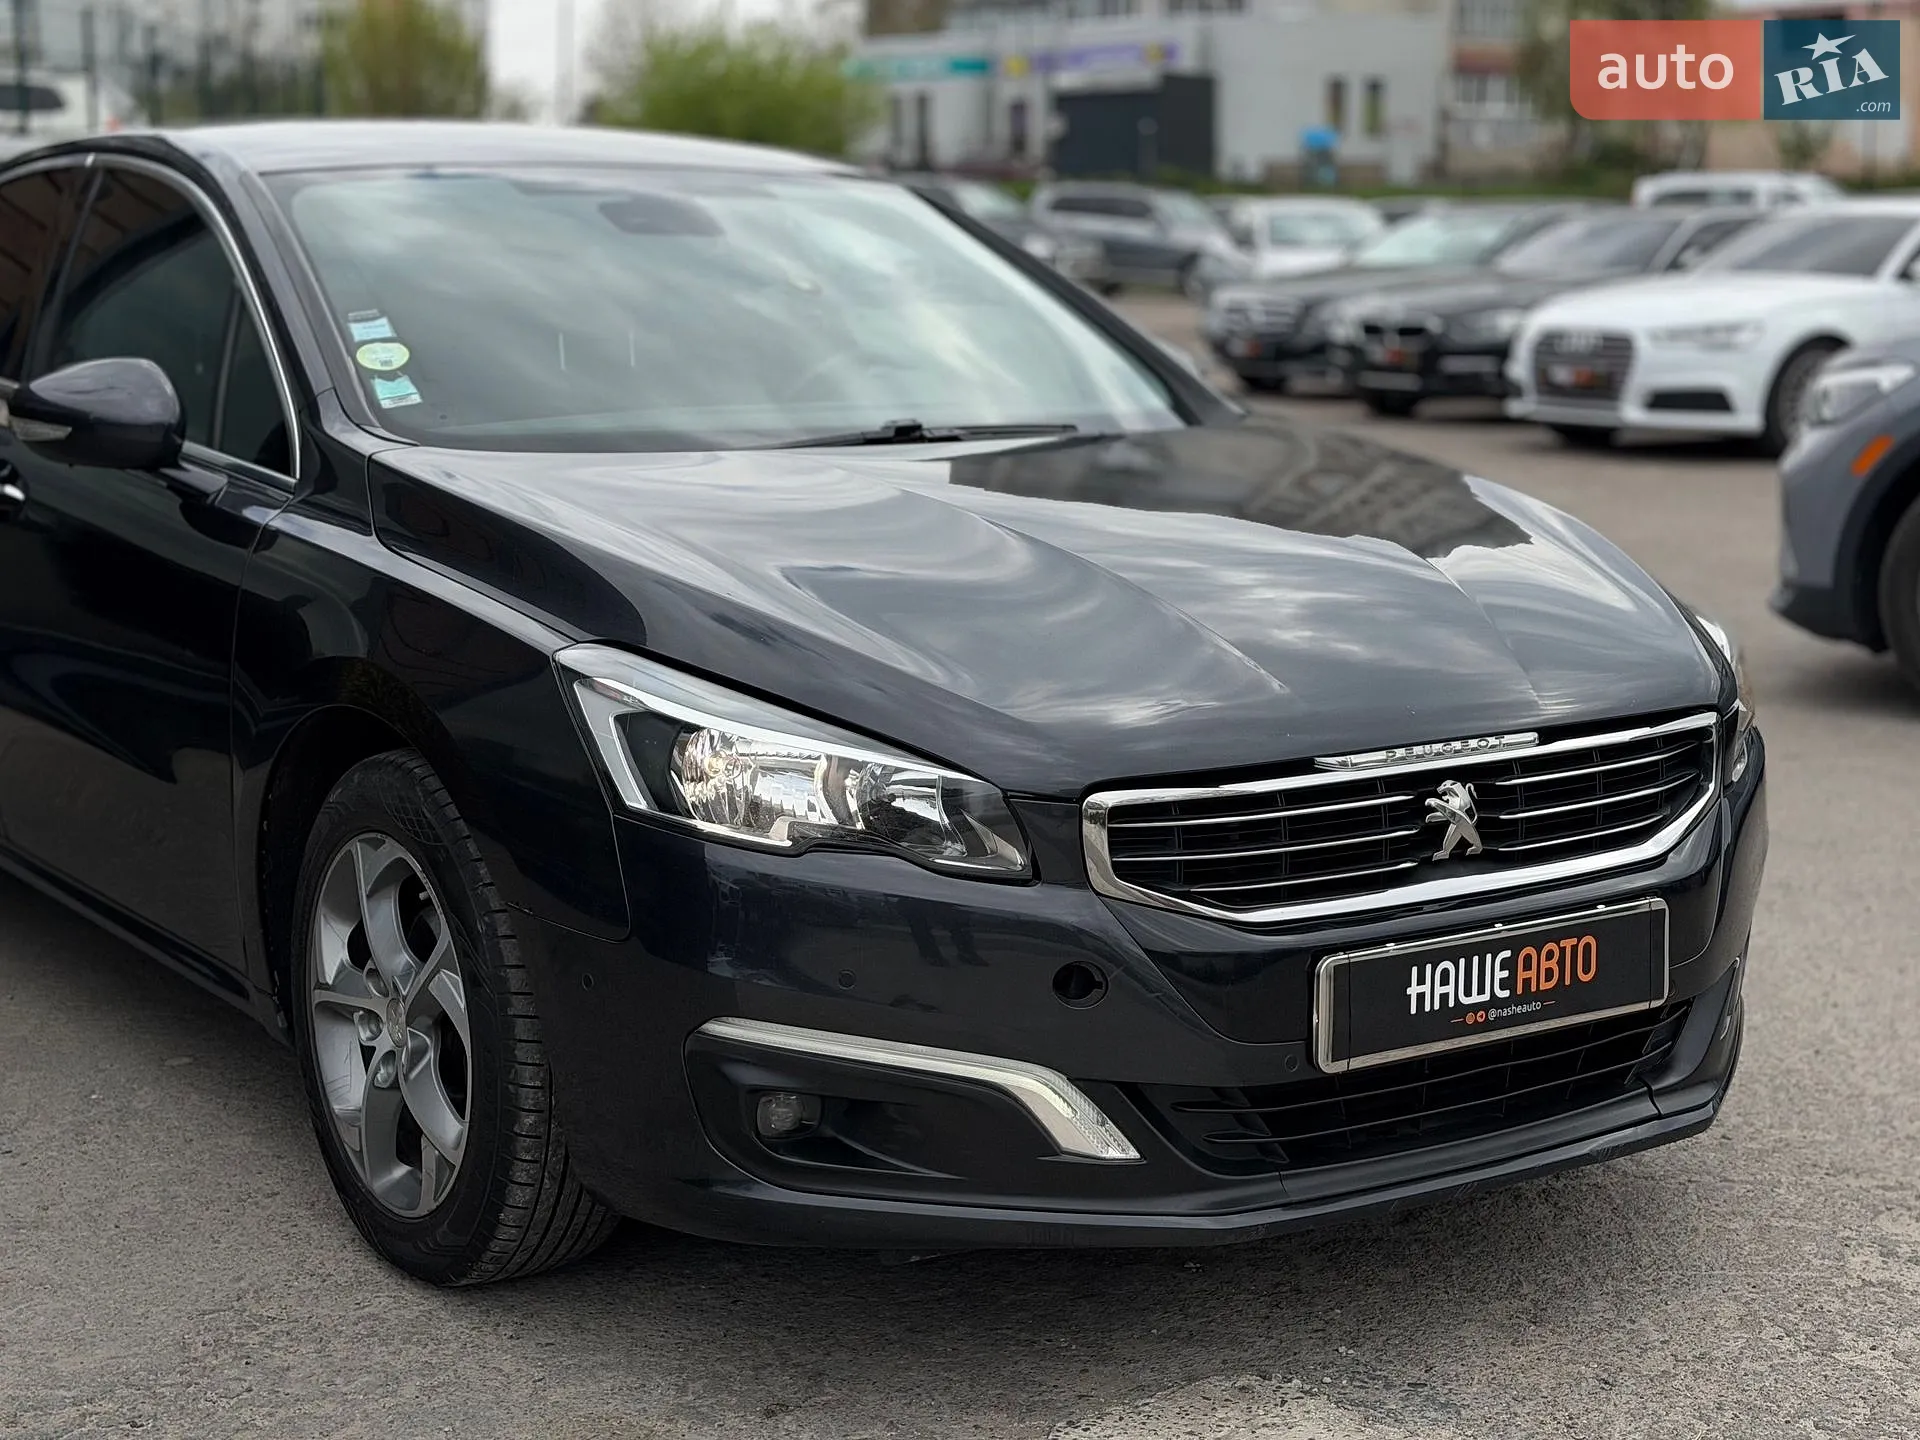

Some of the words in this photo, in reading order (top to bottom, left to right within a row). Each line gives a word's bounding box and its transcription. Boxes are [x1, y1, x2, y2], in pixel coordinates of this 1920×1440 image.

[1384, 735, 1505, 763] PEUGEOT
[1406, 949, 1512, 1015] НАШЕ
[1516, 935, 1598, 995] АВТО
[1487, 1001, 1542, 1020] @nasheauto
